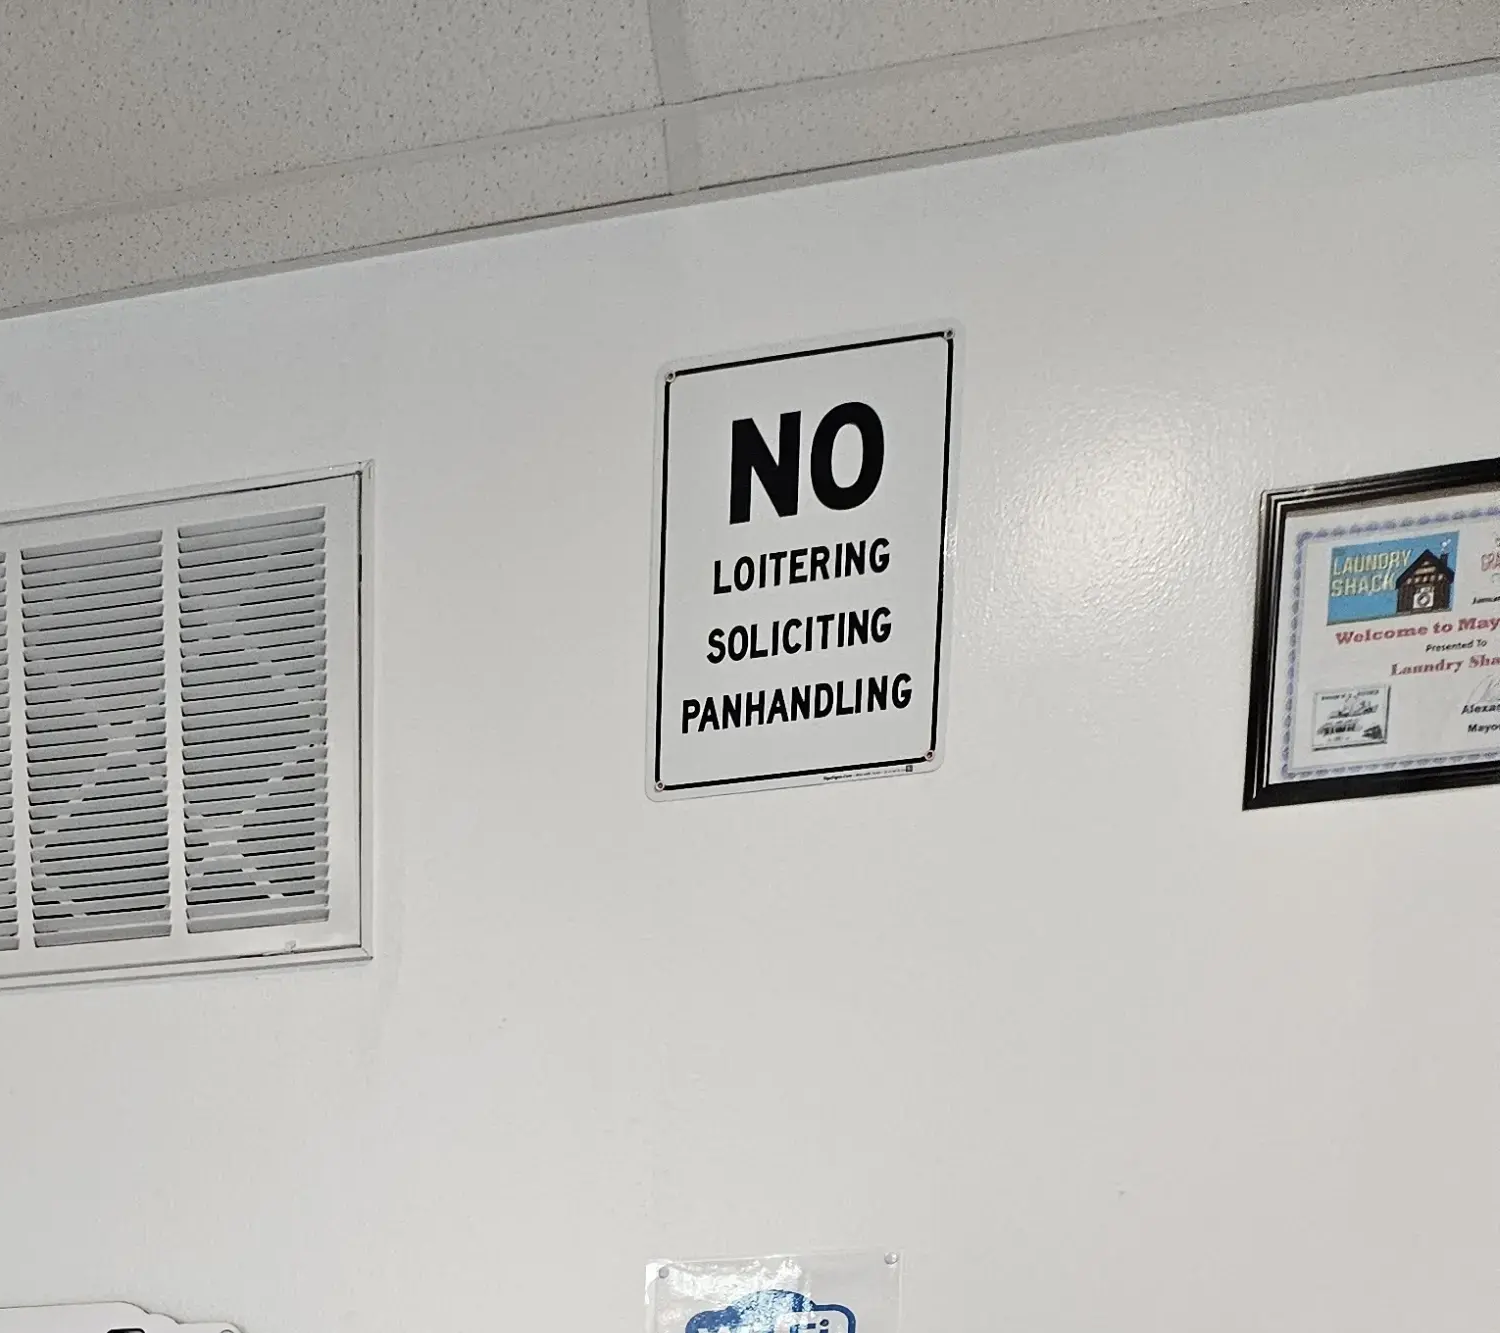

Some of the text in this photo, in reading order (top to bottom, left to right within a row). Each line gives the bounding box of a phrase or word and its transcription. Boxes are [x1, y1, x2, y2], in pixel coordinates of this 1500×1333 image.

[730, 401, 885, 525] NO
[713, 537, 889, 594] LOITERING
[1334, 549, 1412, 575] LAUNDRY
[1331, 572, 1395, 597] SHACK
[707, 607, 892, 664] SOLICITING
[1335, 625, 1428, 645] Welcome
[1433, 622, 1453, 634] to
[1426, 639, 1487, 652] Presented To
[1390, 659, 1464, 676] Laundry
[682, 672, 912, 734] PANHANDLING
